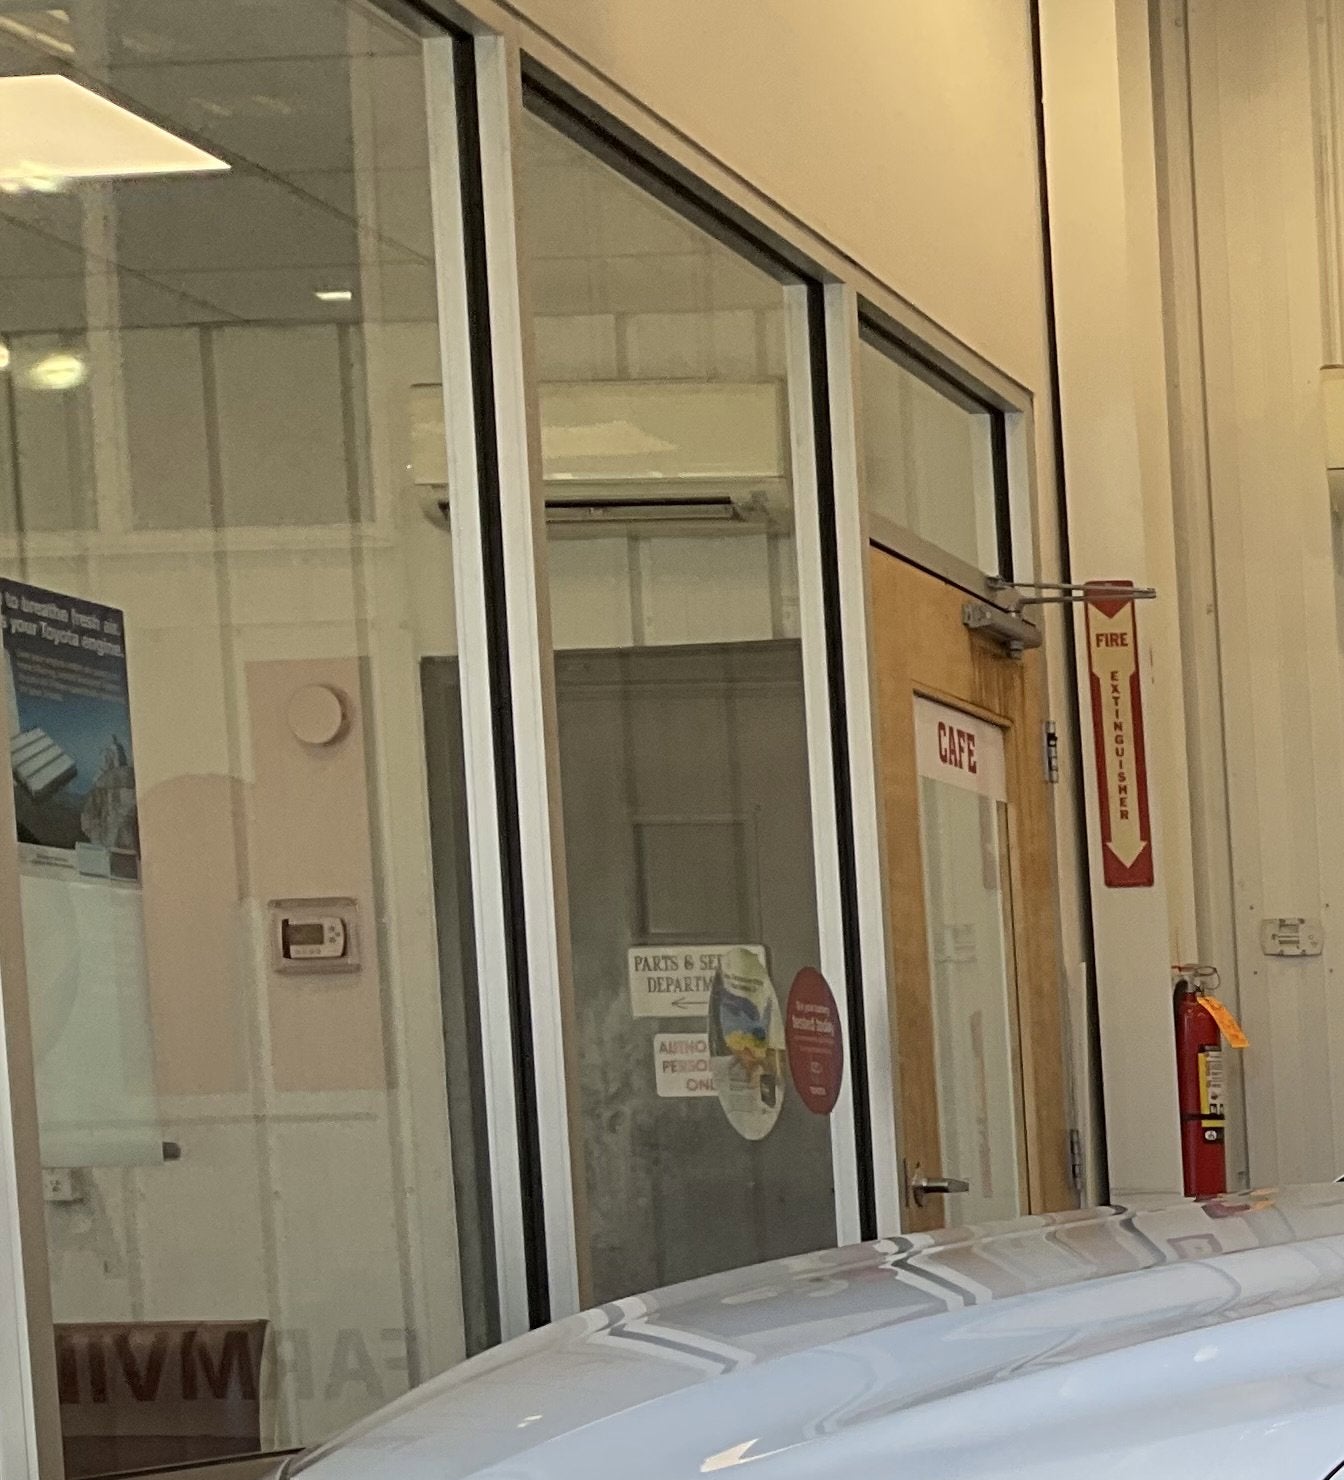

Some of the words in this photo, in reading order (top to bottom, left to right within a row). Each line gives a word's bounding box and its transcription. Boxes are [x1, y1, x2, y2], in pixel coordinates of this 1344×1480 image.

[39, 621, 80, 647] Toyota
[1095, 632, 1128, 648] FIRE
[937, 721, 977, 774] CAFE
[1110, 671, 1129, 820] EXTINGUISHER
[634, 955, 679, 972] PARTS
[683, 955, 695, 971] &
